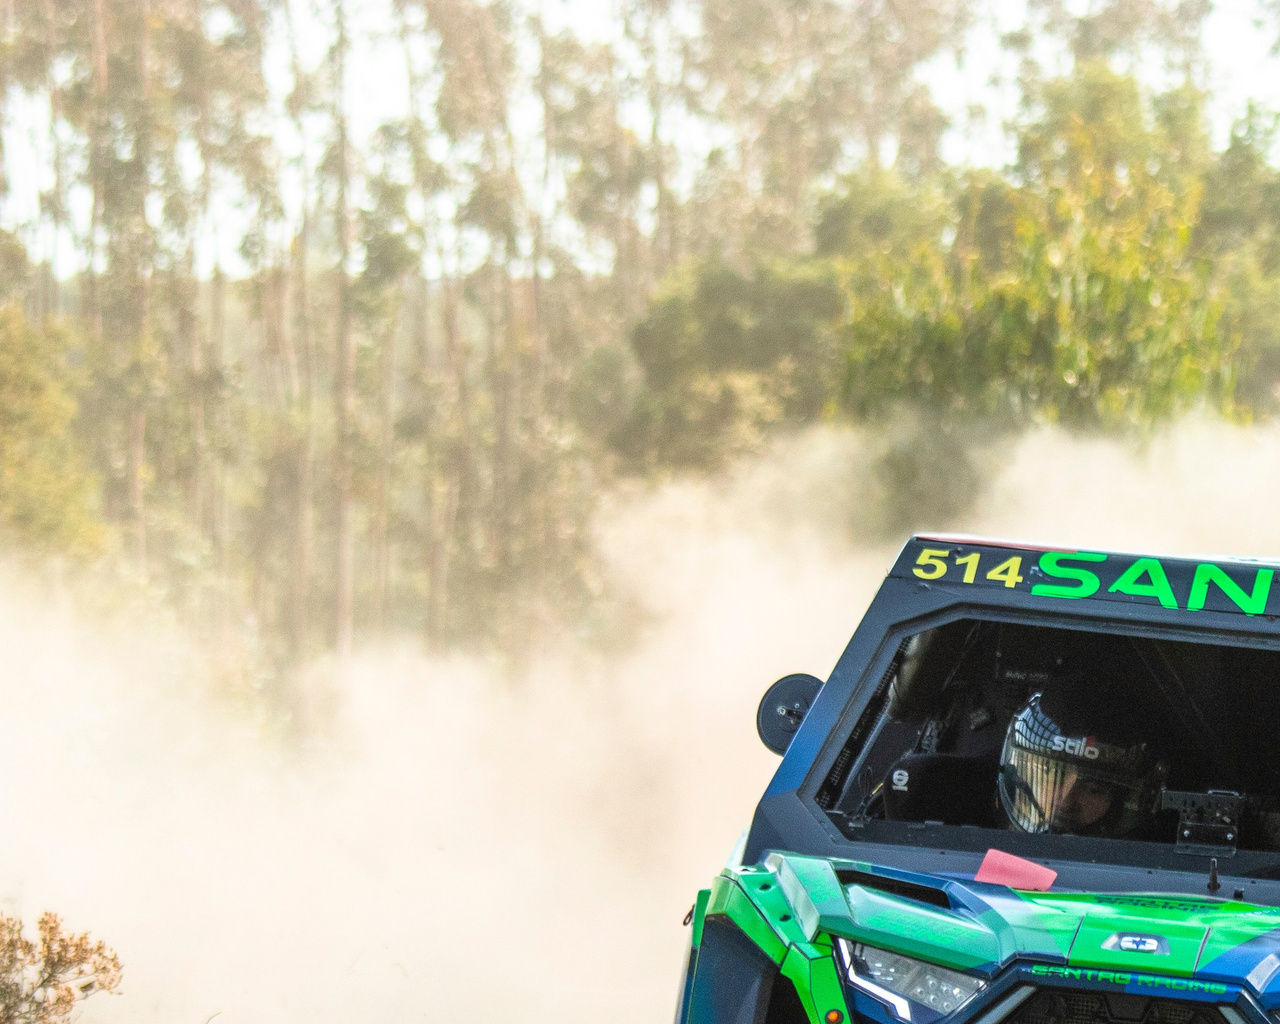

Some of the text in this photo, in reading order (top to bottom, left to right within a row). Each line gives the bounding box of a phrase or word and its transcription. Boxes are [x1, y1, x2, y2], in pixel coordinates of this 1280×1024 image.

[912, 549, 1023, 588] 514
[1032, 965, 1227, 994] SANTAG RACING
